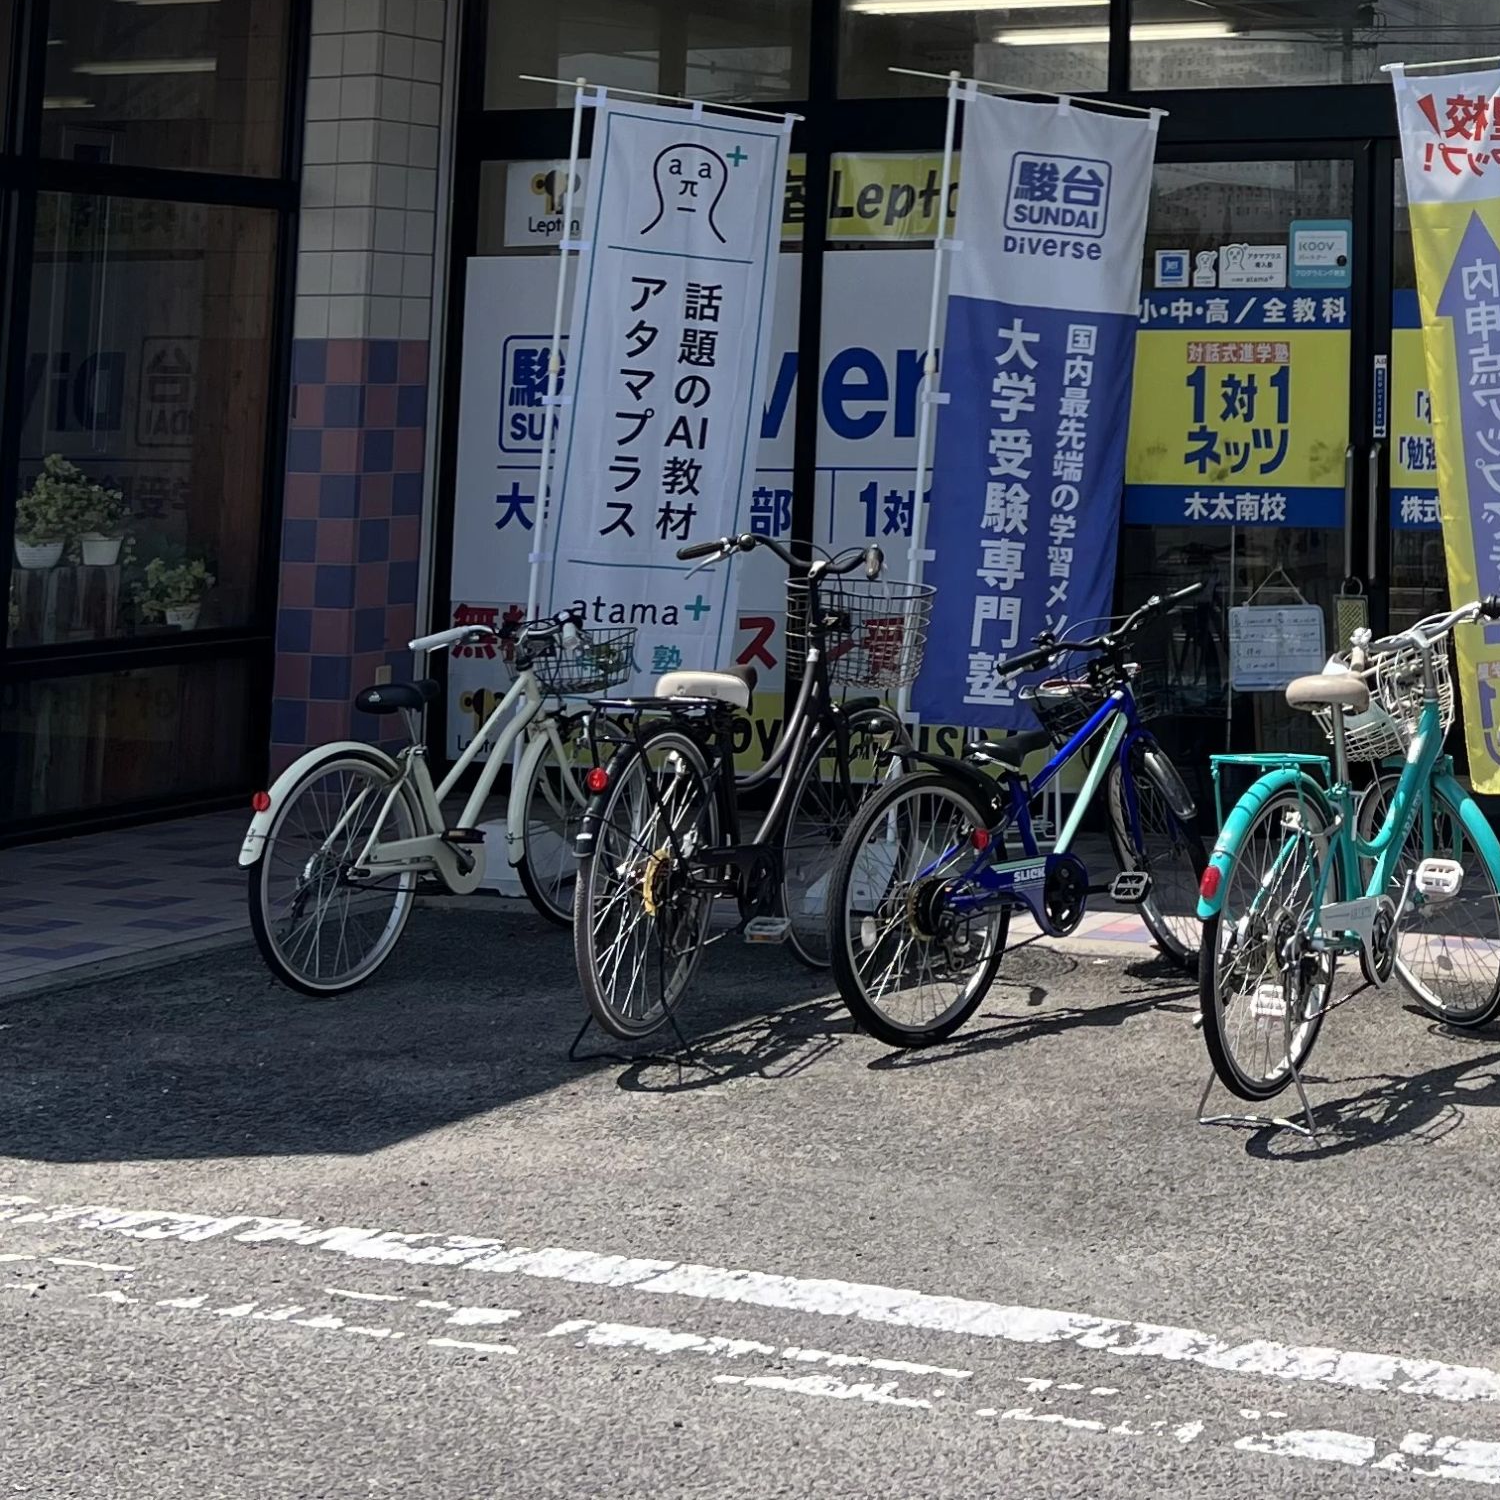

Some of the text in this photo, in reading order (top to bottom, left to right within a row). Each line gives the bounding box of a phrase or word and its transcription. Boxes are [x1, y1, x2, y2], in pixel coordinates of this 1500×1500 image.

[1014, 160, 1104, 203] 駿台
[528, 216, 580, 237] Leptn
[1013, 203, 1099, 231] SUNDAI
[1188, 342, 1290, 364] 対話式進学塾
[599, 275, 668, 538] アタマプラス
[655, 282, 724, 542] 話題のAI教材
[1186, 365, 1290, 426] 1対1
[1184, 426, 1290, 476] ネッツ
[1184, 493, 1287, 523] 木太南校
[1400, 495, 1443, 524] 株式
